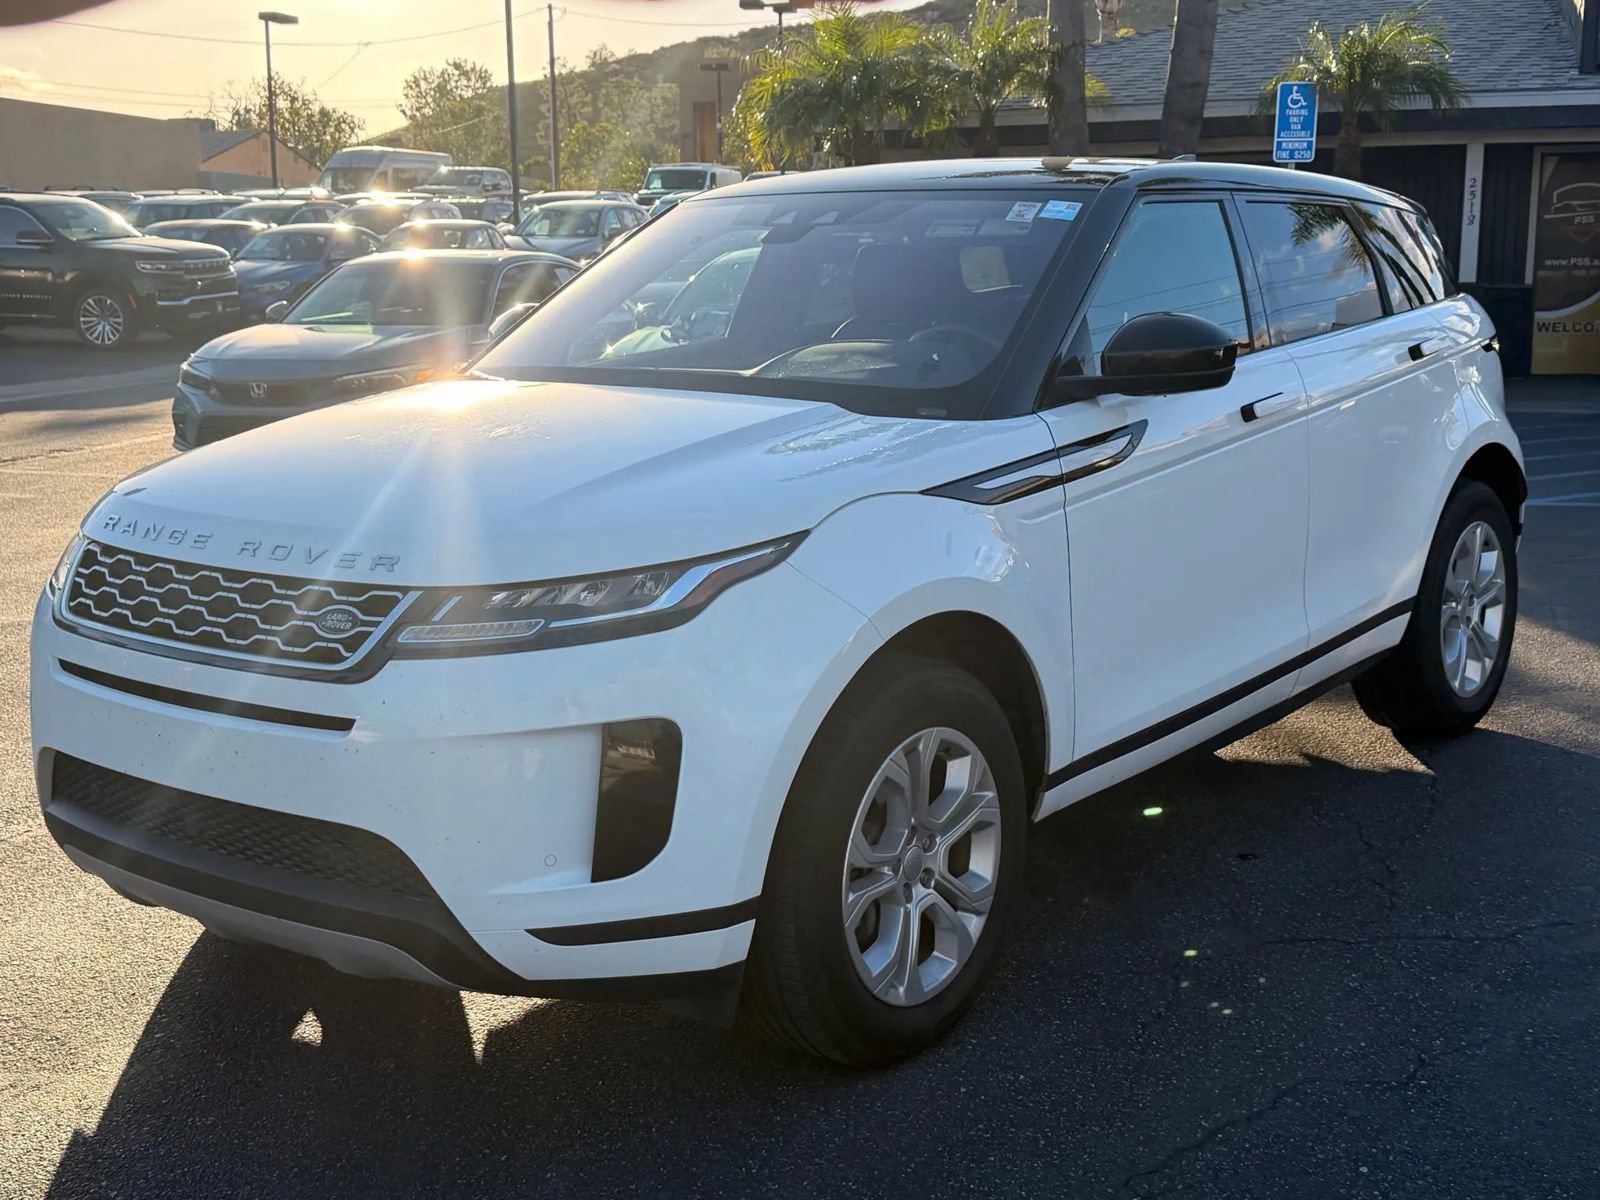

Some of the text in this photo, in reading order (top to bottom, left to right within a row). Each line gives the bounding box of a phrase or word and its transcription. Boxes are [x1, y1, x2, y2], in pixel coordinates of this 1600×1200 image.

[1280, 130, 1310, 138] ACCESSIBLE
[1281, 142, 1308, 150] MINIMUM
[1277, 151, 1311, 159] FINE $250
[1574, 214, 1595, 224] PSS
[1544, 256, 1600, 266] www.PSS.a
[101, 514, 401, 572] RANGE ROVER
